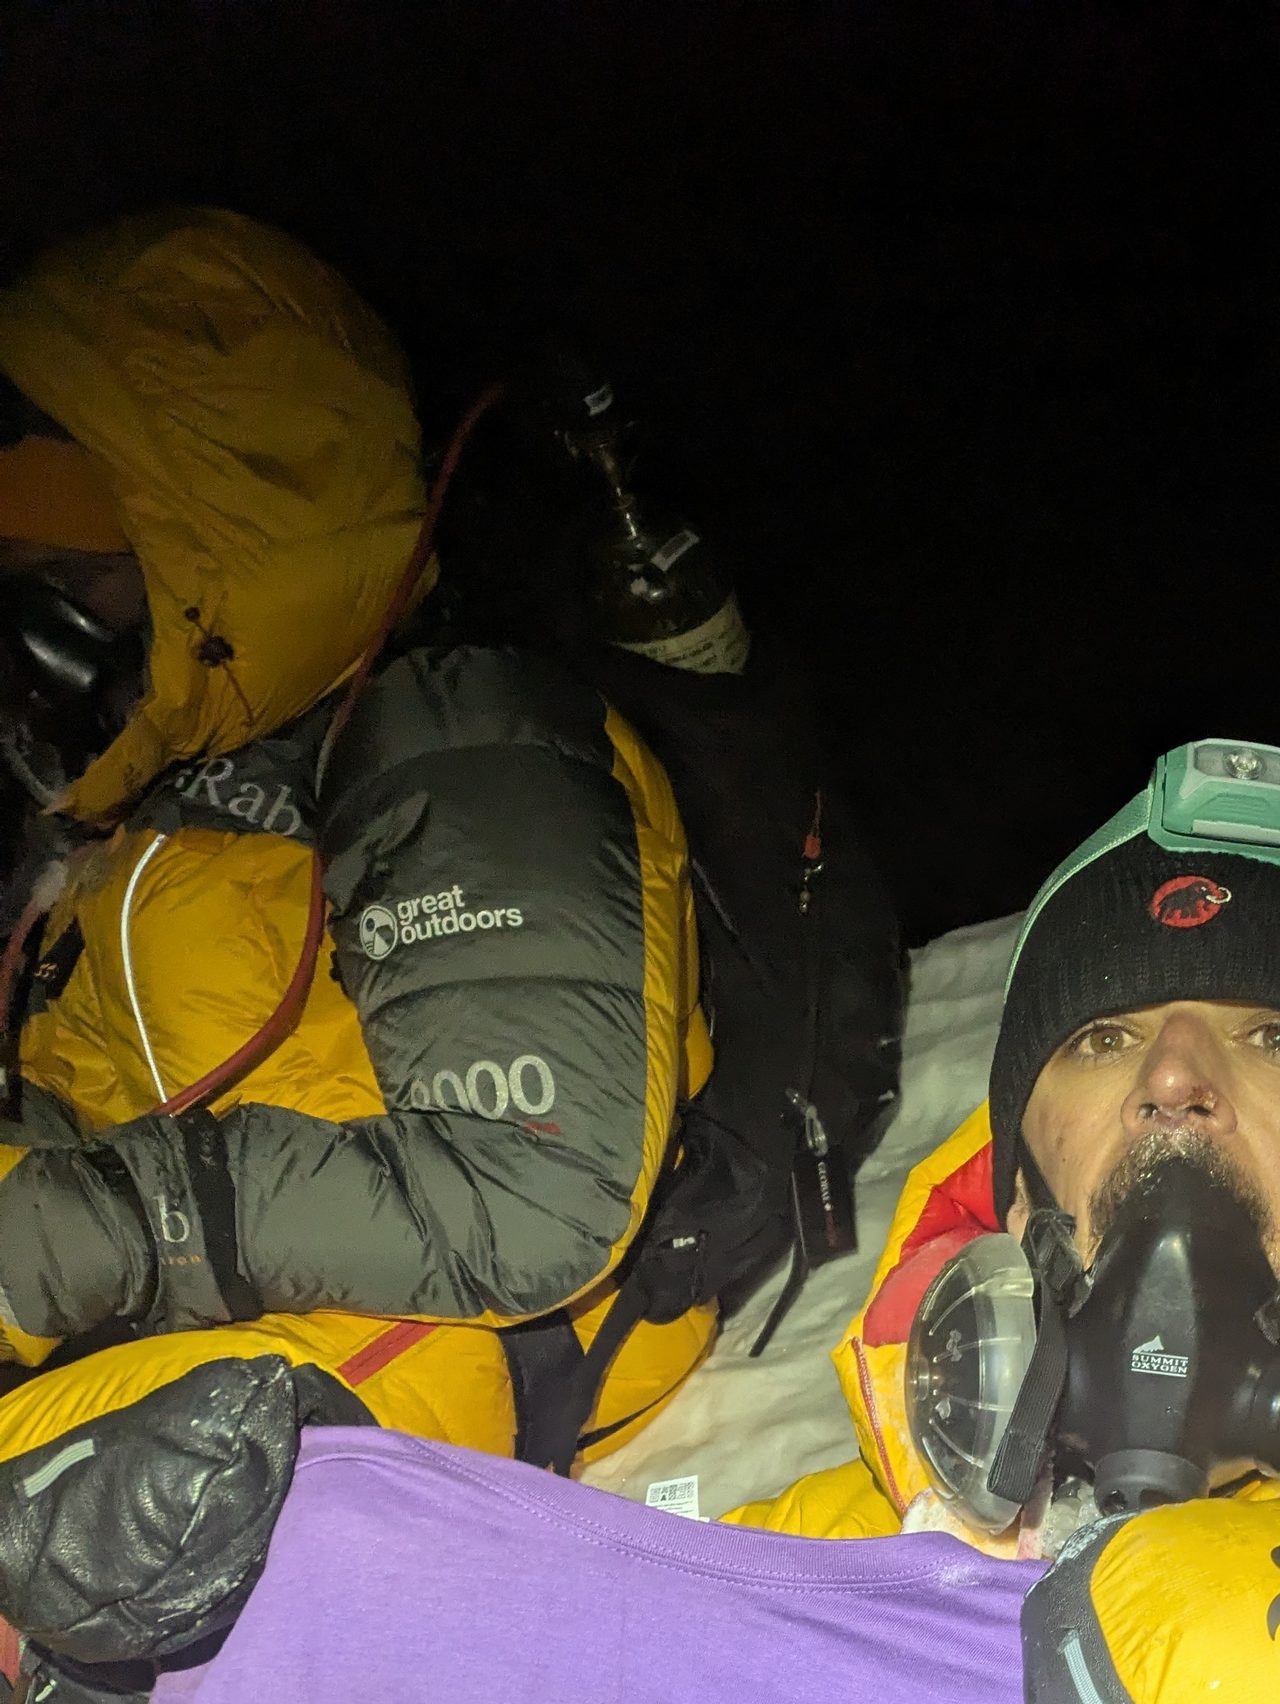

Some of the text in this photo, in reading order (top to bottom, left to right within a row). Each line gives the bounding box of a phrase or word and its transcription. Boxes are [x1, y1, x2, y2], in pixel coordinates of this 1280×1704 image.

[180, 758, 302, 836] Rab
[397, 885, 465, 926] great
[400, 907, 524, 945] outdoors
[1131, 1354, 1189, 1367] SUMMIT
[1131, 1361, 1188, 1374] OXYGEN
